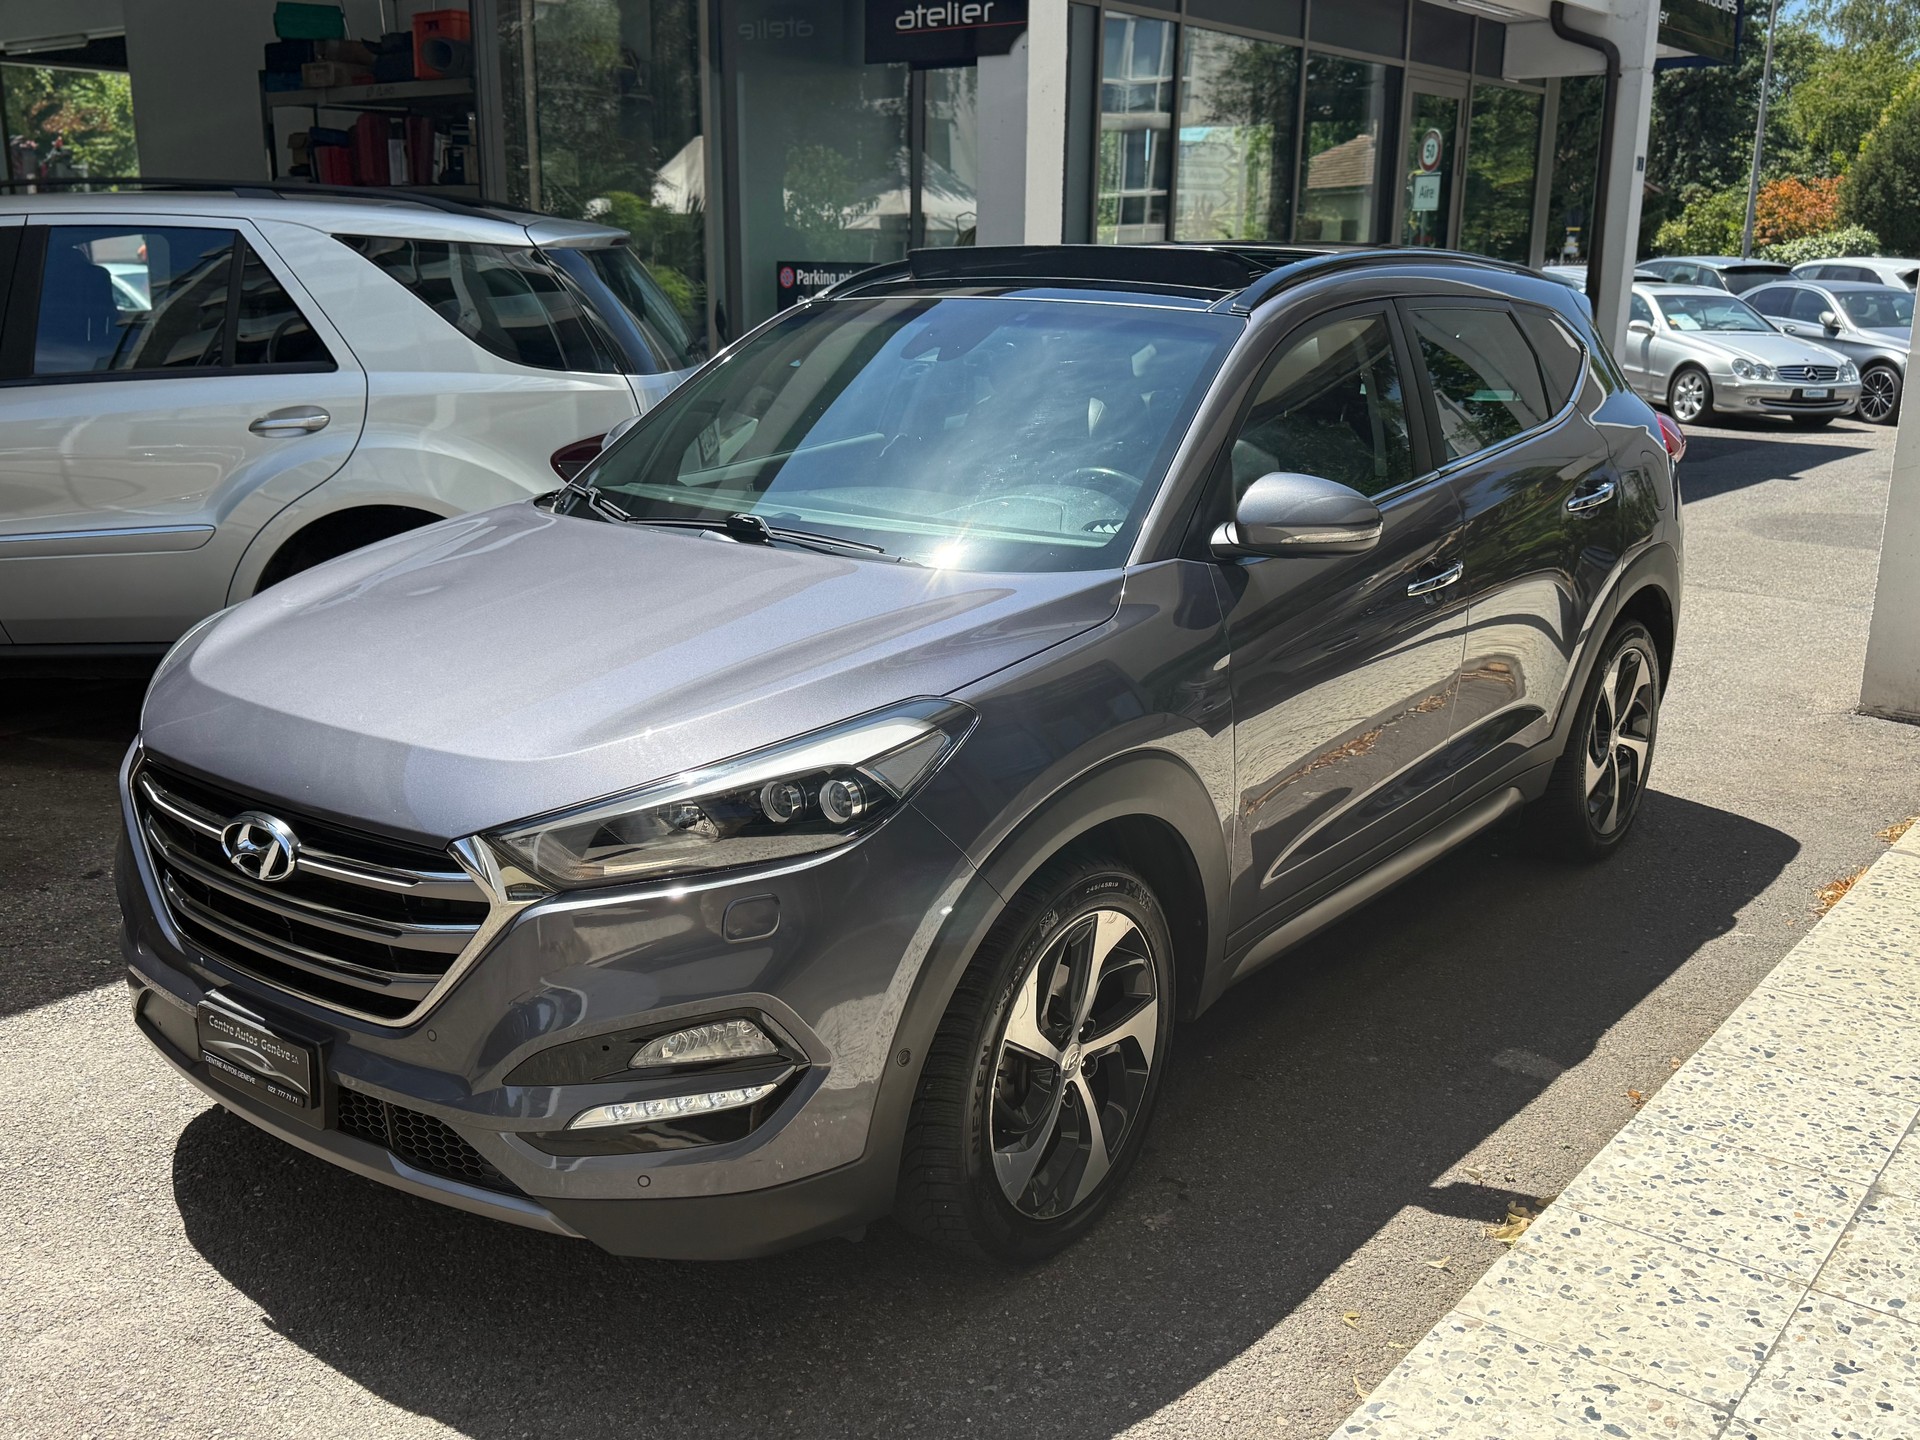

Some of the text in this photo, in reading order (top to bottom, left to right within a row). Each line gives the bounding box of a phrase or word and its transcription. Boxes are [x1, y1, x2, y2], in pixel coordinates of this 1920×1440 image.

[895, 2, 994, 30] atelier
[1425, 143, 1436, 159] 50
[796, 269, 836, 285] Parking
[208, 1015, 234, 1035] Centre
[235, 1027, 258, 1046] Autos
[260, 1039, 291, 1061] Genève
[205, 1055, 223, 1068] CENTRE
[223, 1064, 237, 1075] AUTOS
[971, 1045, 992, 1155] NEXEN
